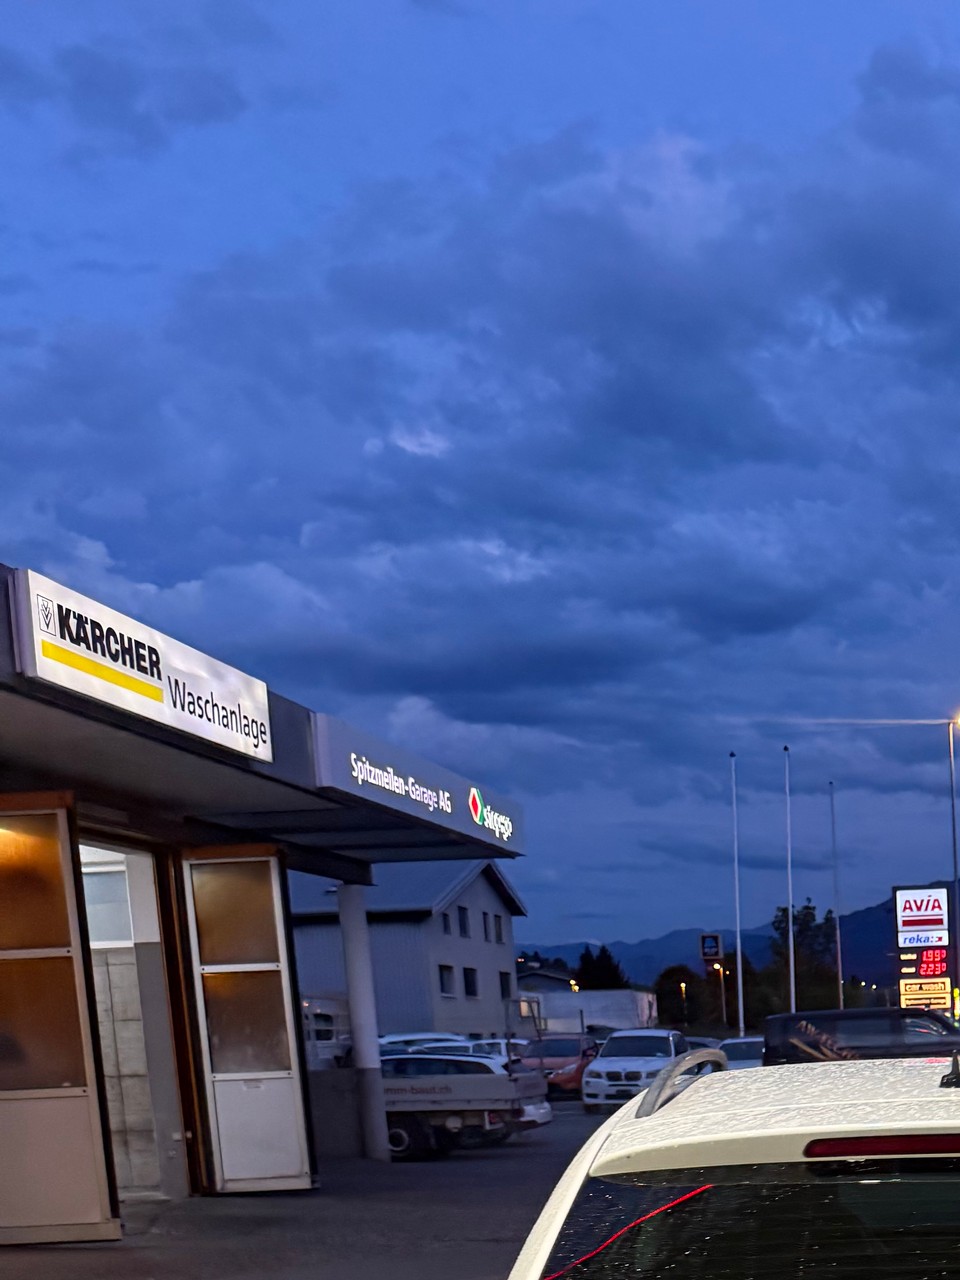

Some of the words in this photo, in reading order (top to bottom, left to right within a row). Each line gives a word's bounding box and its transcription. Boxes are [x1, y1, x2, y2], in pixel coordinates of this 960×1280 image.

[57, 603, 162, 681] KÄRCHER
[168, 675, 267, 748] Waschanlage
[351, 752, 438, 811] Spitzmeilen-Garage
[439, 789, 452, 813] AG
[902, 895, 943, 912] AVIA
